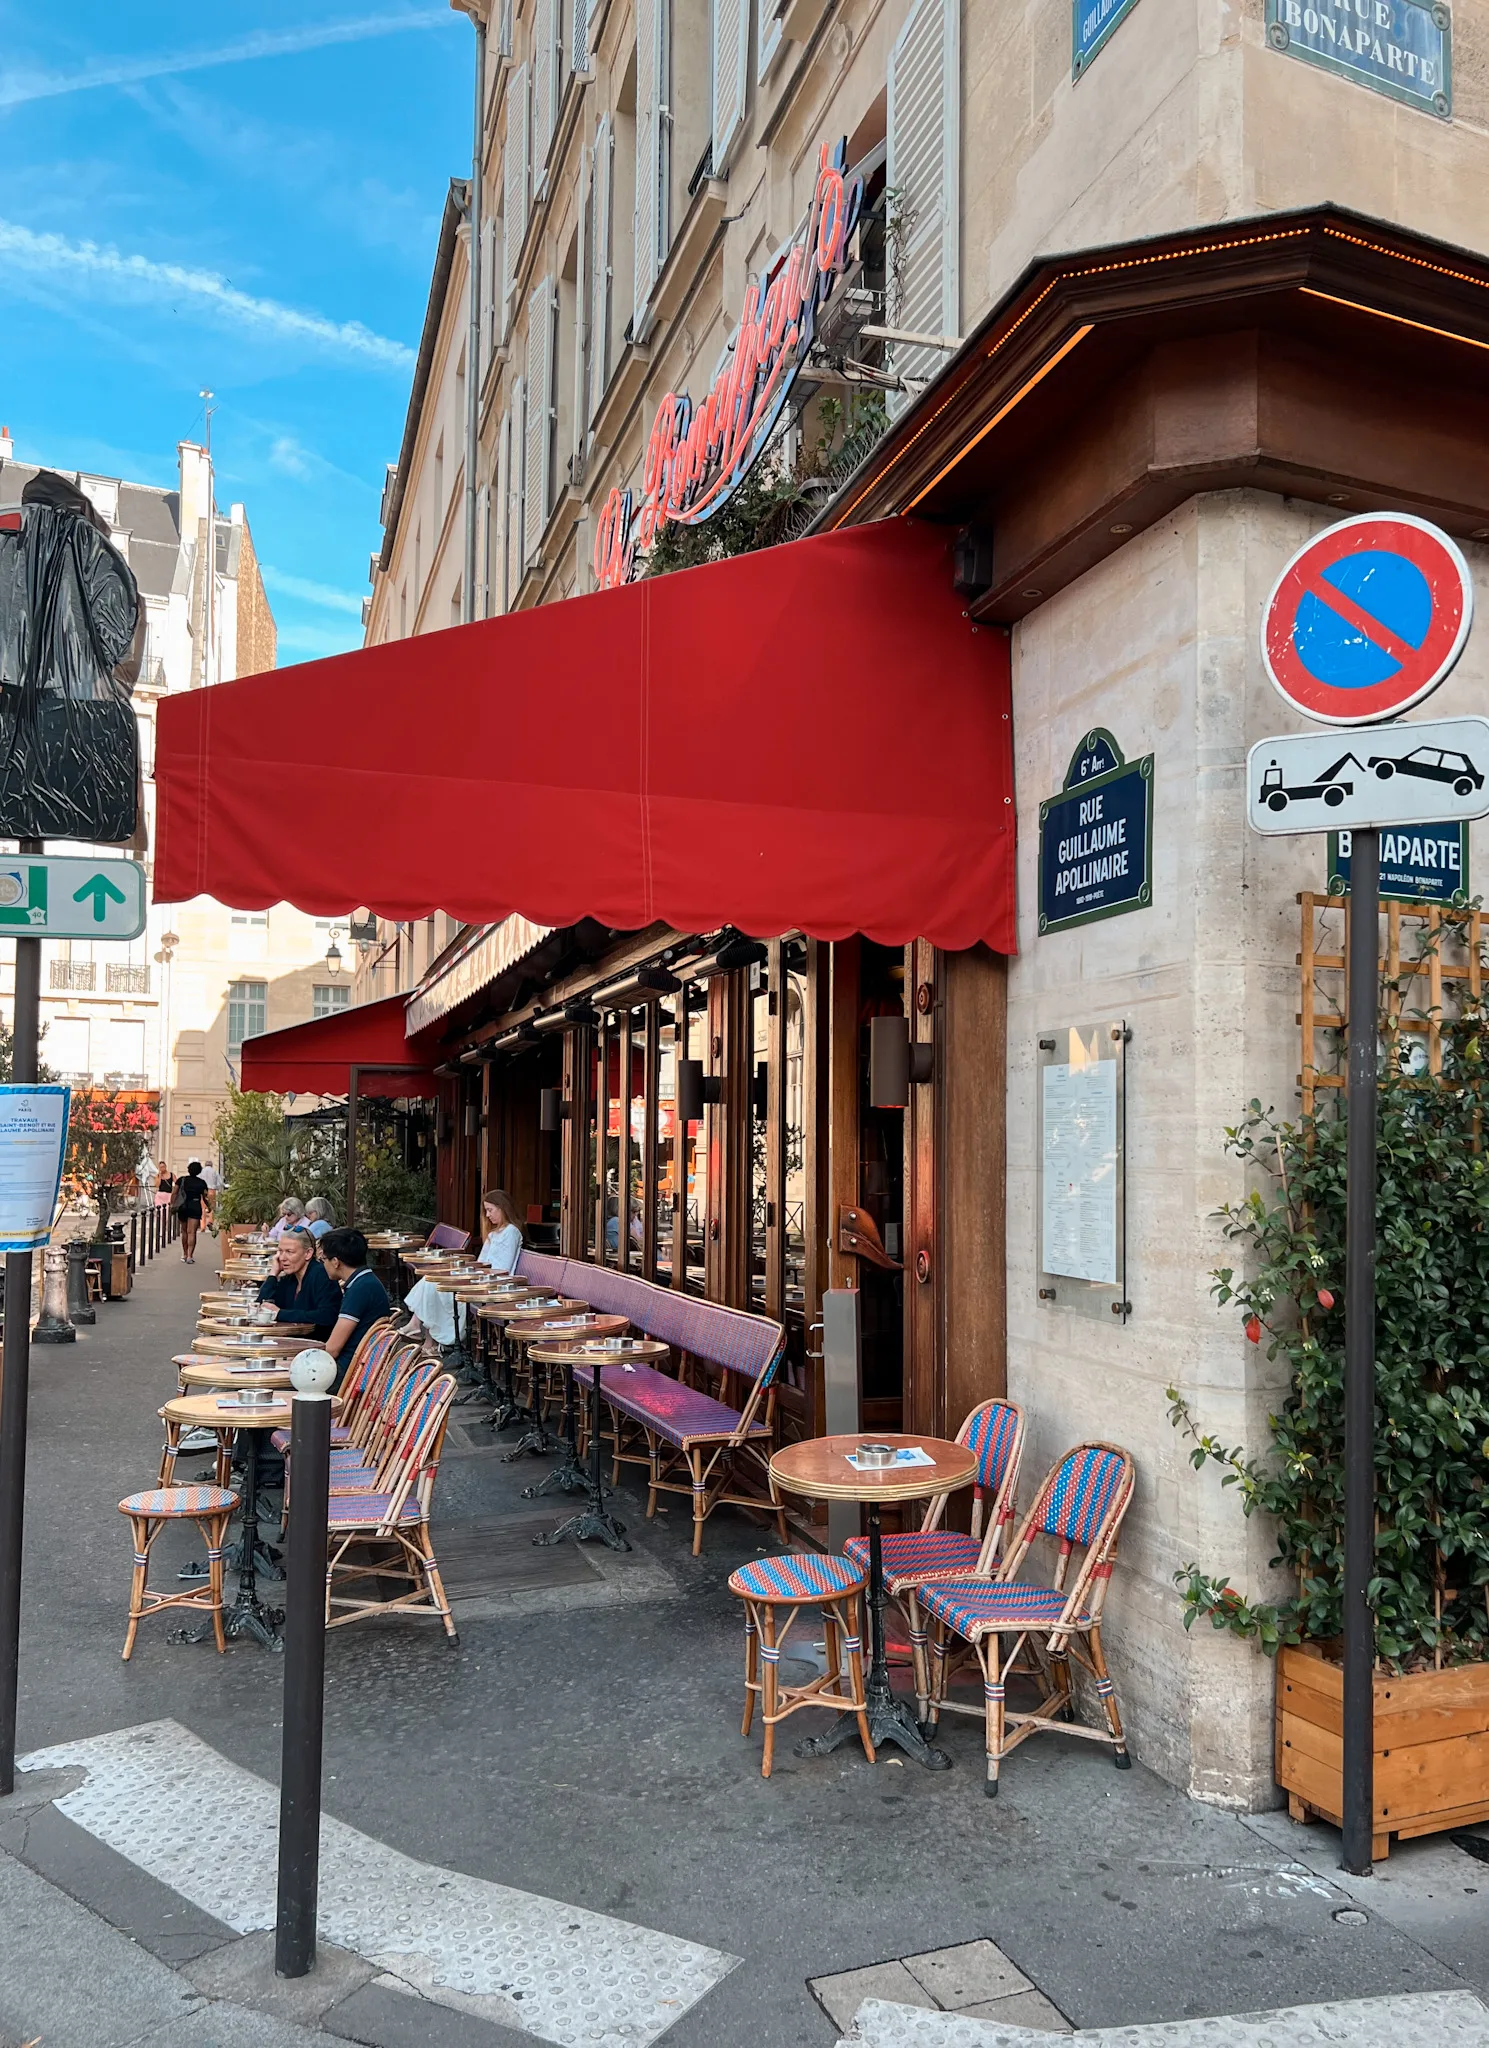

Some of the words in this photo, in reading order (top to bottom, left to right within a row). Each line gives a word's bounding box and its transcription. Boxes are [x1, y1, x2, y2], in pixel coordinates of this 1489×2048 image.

[1284, 0, 1436, 86] BONAPARTE
[1079, 795, 1103, 826] RUE
[1058, 818, 1127, 864] GUILLAUME
[1338, 830, 1461, 871] BAPARTE
[1055, 850, 1129, 897] APOLLINAIRE
